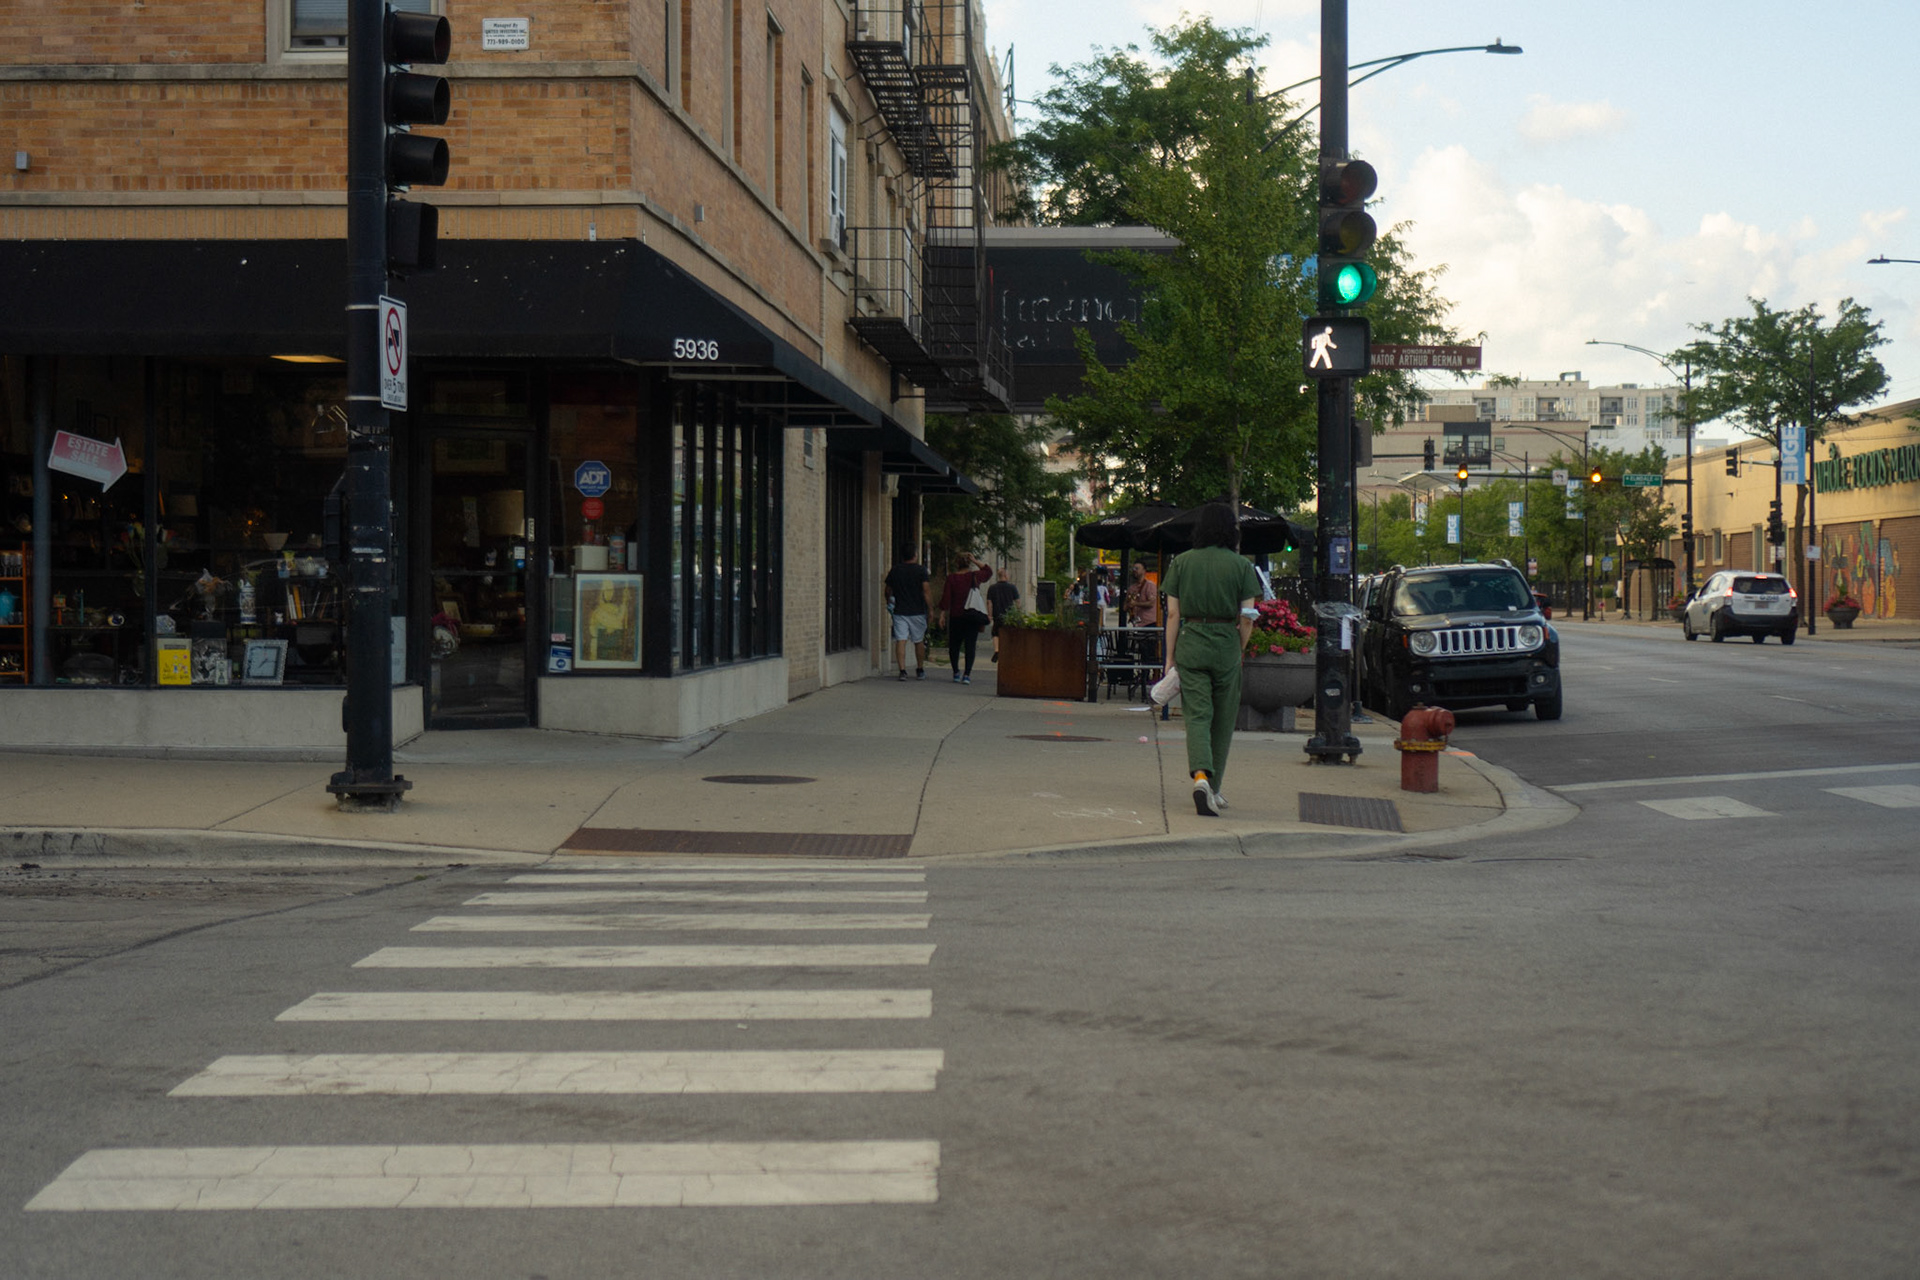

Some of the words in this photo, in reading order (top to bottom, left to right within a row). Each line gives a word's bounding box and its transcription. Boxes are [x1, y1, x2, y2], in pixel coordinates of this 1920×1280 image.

[674, 339, 719, 360] 5936
[1399, 354, 1428, 366] ARTHUR
[1432, 354, 1462, 367] BERMAN
[393, 377, 397, 394] 5
[67, 437, 109, 457] ESTATE
[1781, 427, 1800, 484] EDGE
[70, 450, 99, 467] SALE
[1851, 447, 1889, 490] FOODS
[579, 471, 607, 485] ADT
